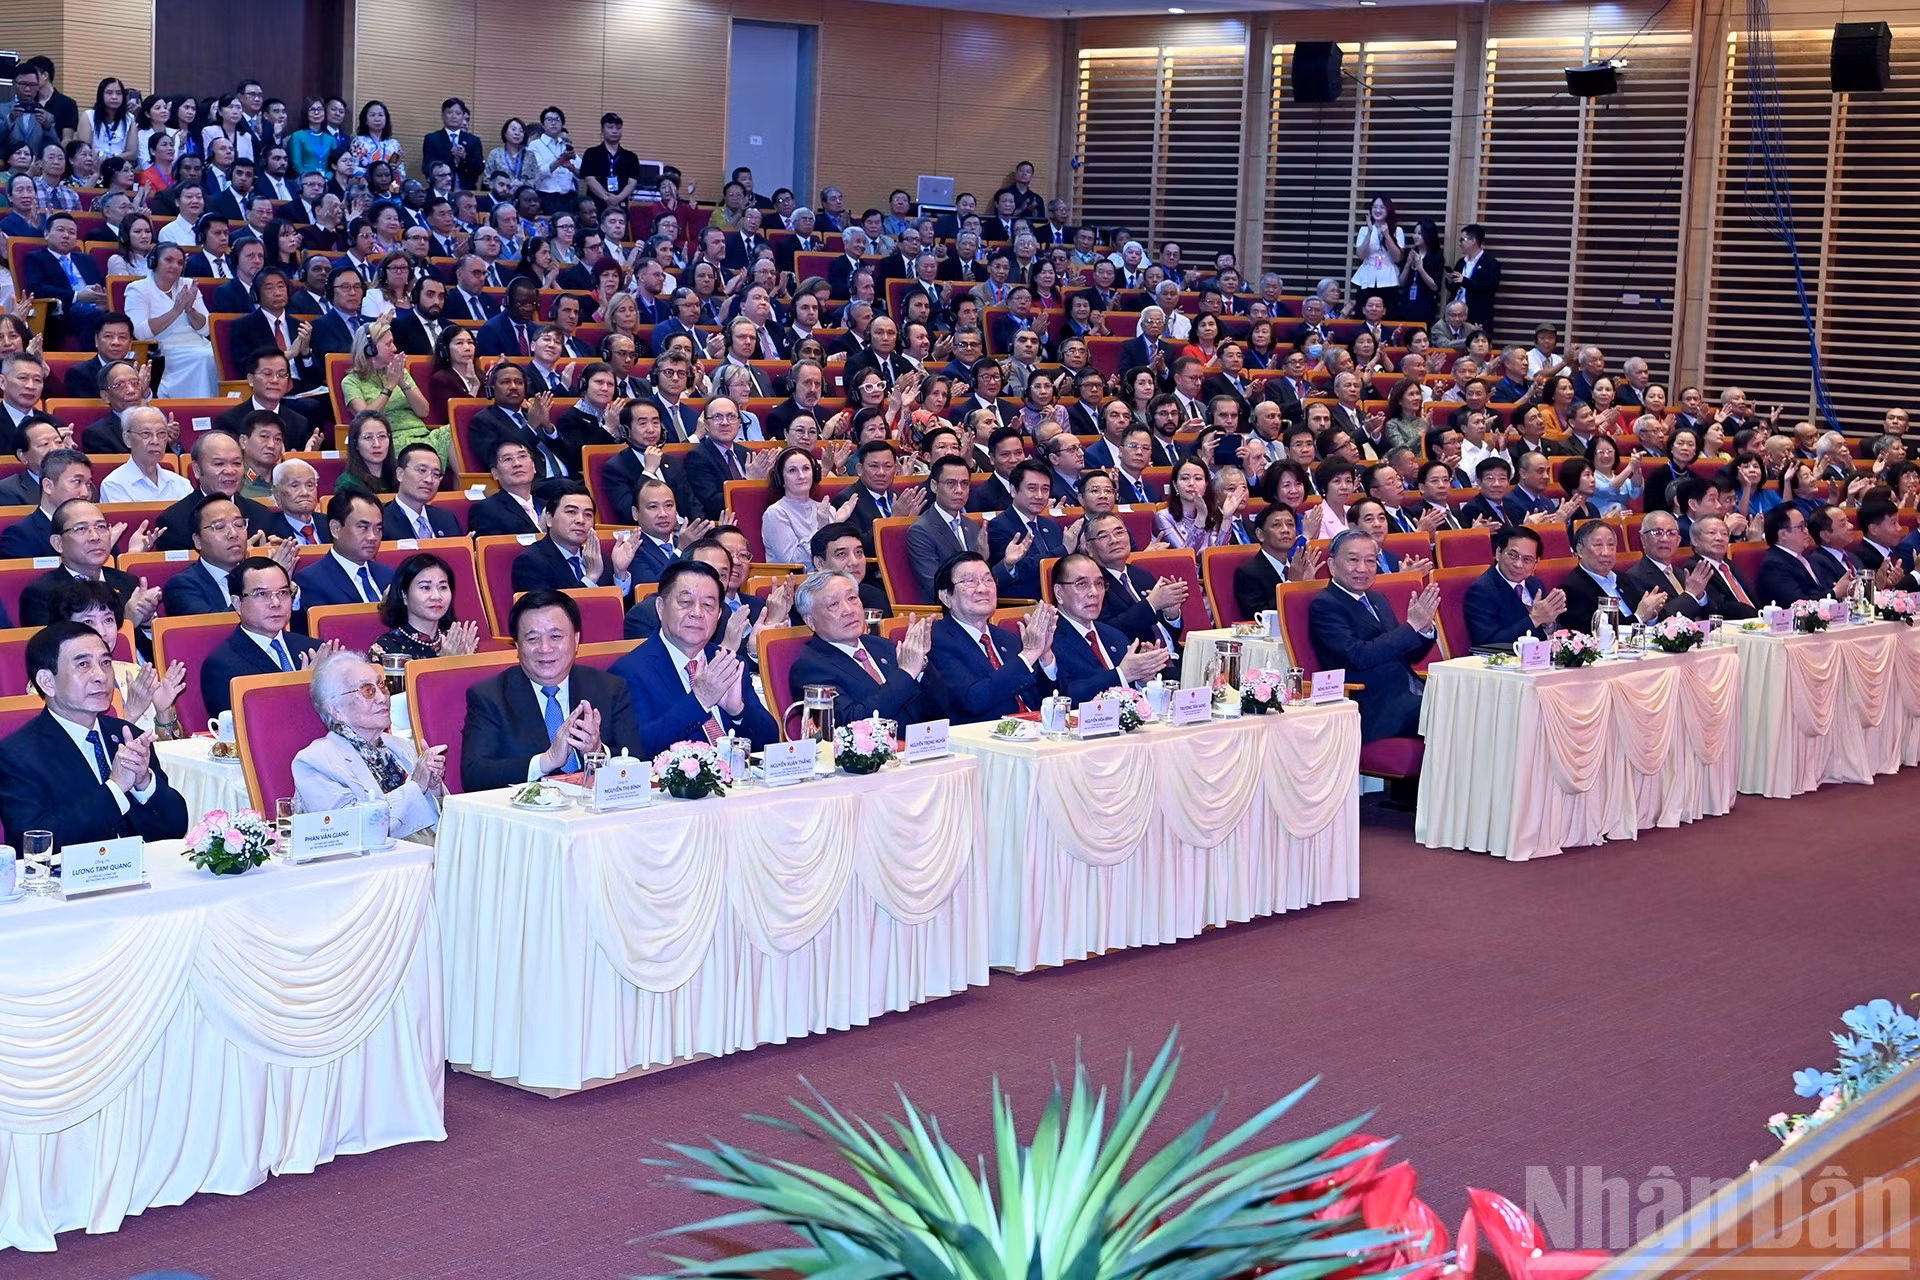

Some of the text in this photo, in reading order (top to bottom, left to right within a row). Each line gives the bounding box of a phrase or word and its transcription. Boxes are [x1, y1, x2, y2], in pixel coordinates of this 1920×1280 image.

[910, 740, 923, 748] NGUYỄN
[770, 760, 786, 768] NGUYỄN
[604, 785, 622, 794] NGUYỄN
[304, 830, 350, 842] PHAN VĂN GIANG
[72, 866, 95, 876] LƯƠNG
[95, 864, 109, 872] TAM
[109, 861, 132, 871] QUANG
